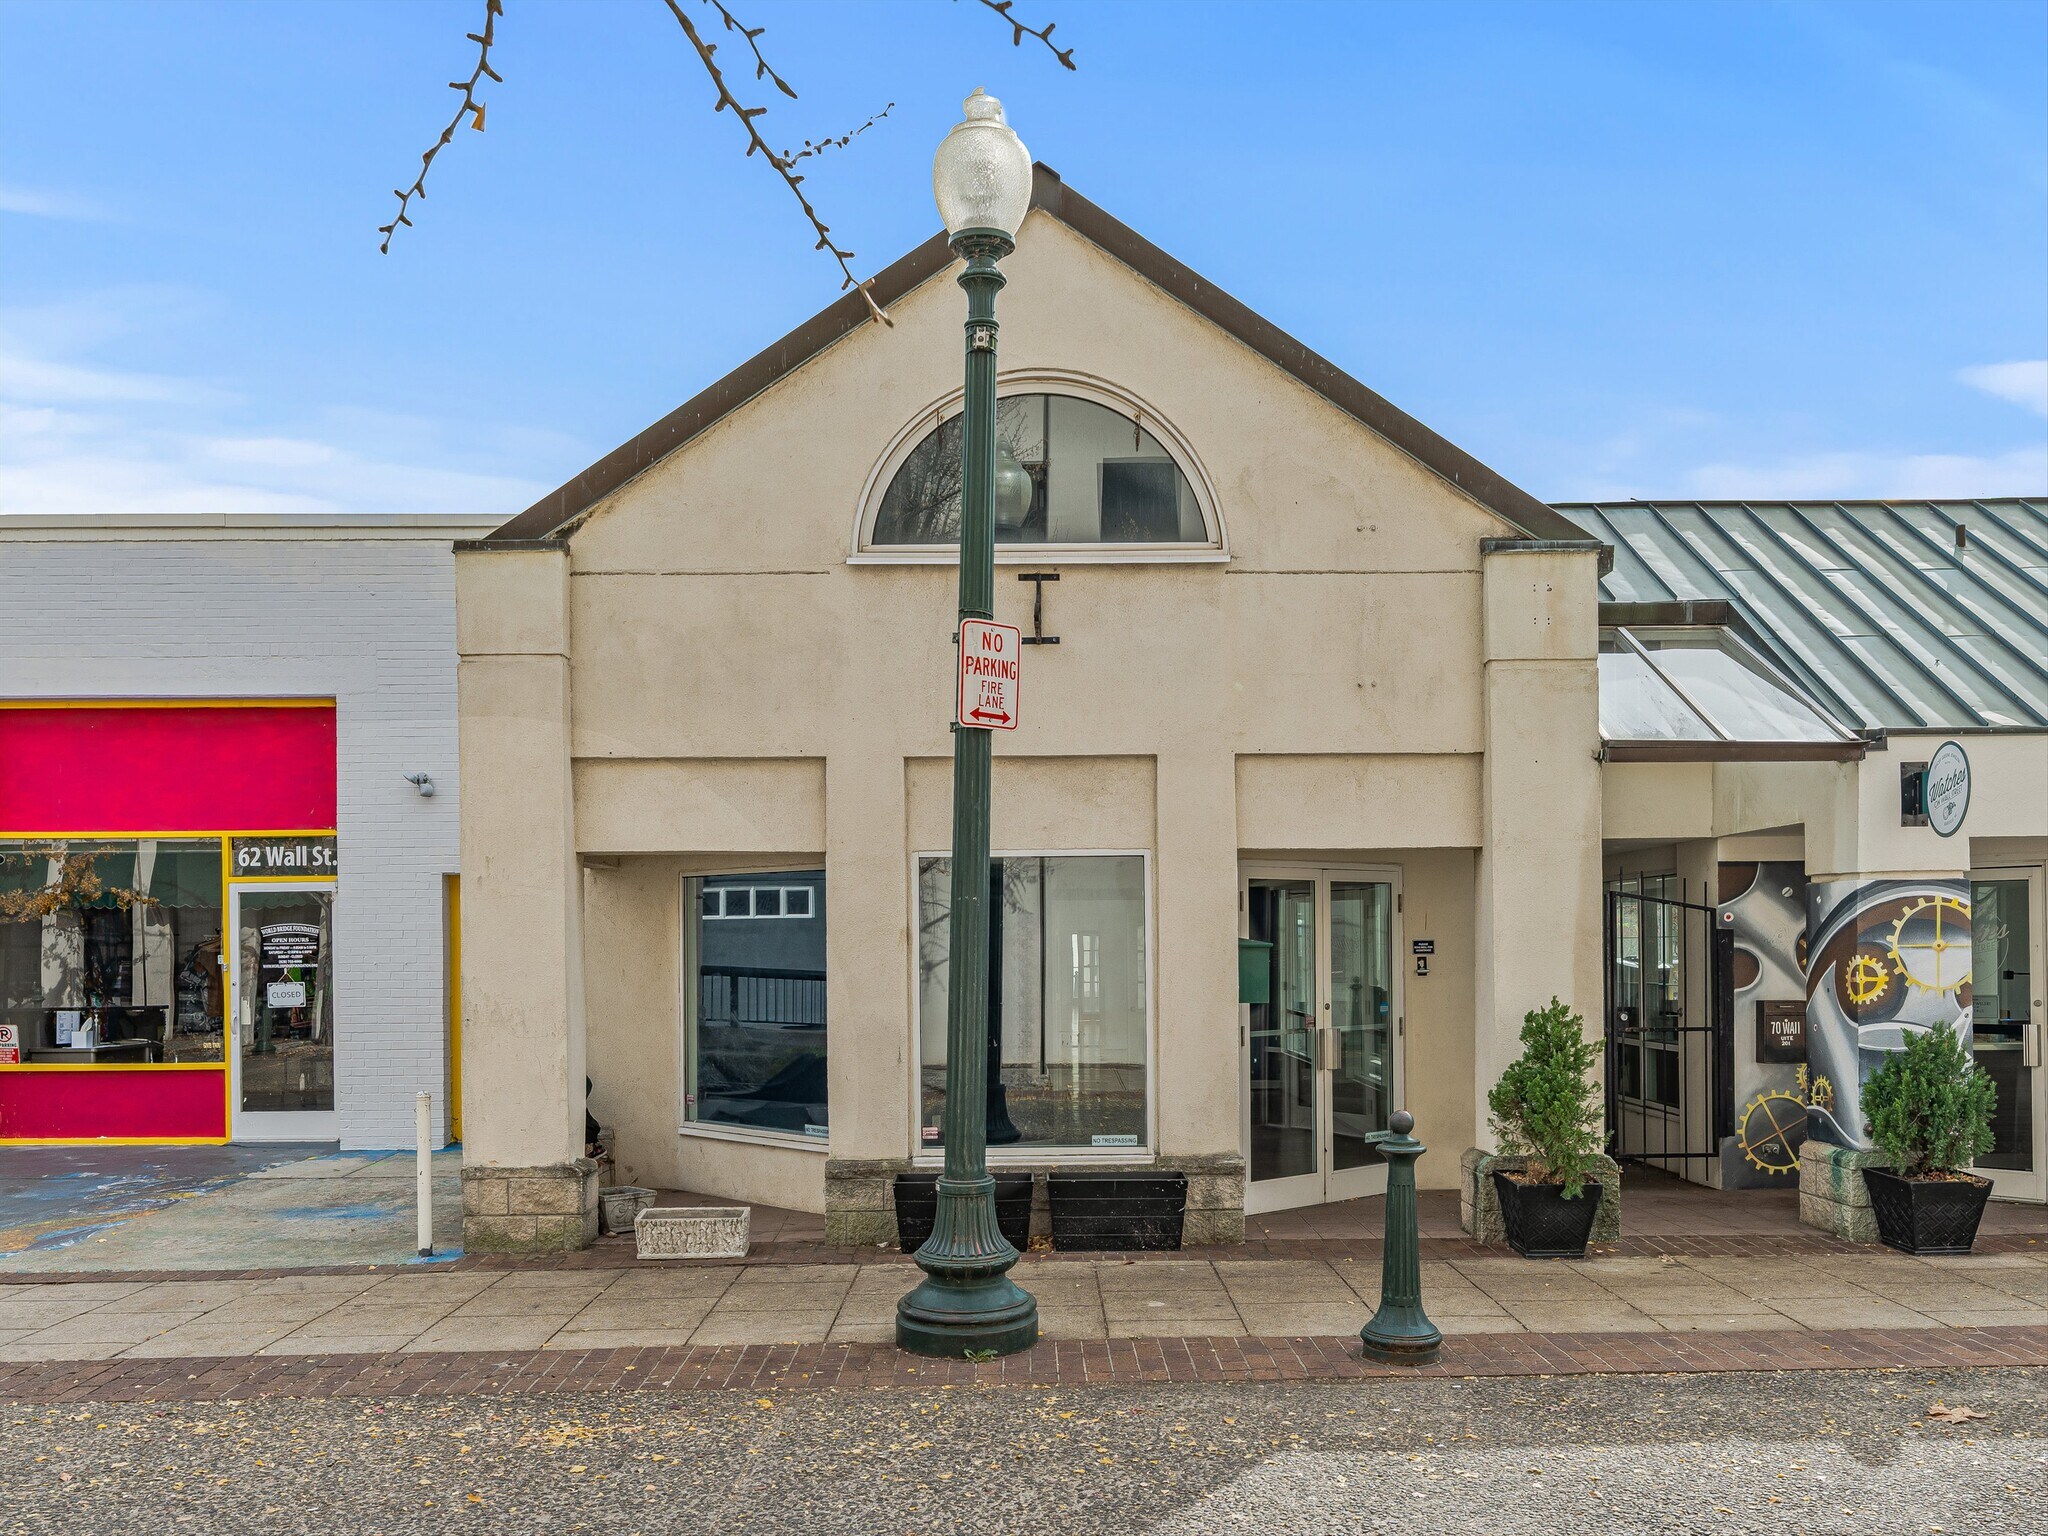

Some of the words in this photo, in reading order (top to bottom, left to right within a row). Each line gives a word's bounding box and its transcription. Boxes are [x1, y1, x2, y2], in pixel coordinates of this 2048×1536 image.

[982, 631, 1003, 653] NO
[965, 655, 1016, 680] PARKING
[981, 680, 1003, 695] FIRE
[978, 694, 1004, 710] LANE
[1928, 767, 1967, 803] Watches
[238, 847, 261, 867] 62
[265, 845, 307, 867] Wall
[312, 845, 338, 867] St.
[271, 990, 302, 999] CLOSED
[1771, 1021, 1781, 1035] 70
